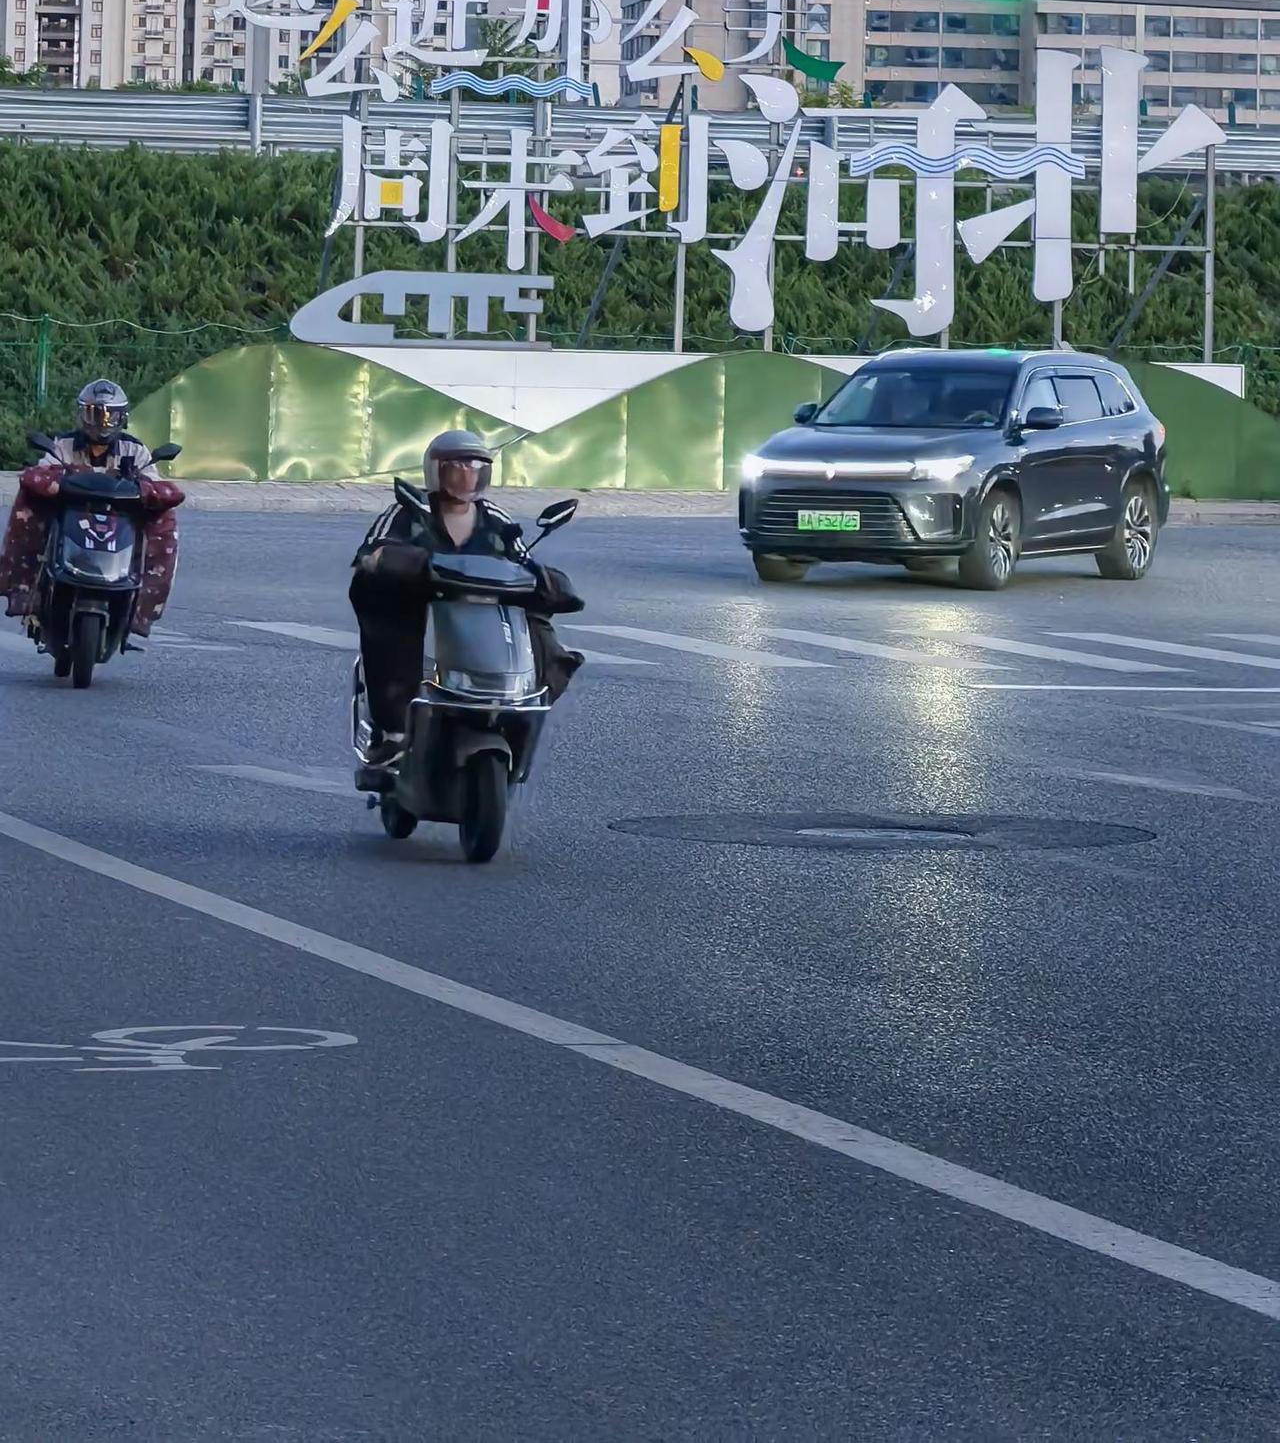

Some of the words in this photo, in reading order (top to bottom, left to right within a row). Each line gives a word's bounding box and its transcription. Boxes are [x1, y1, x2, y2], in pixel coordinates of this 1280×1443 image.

[324, 45, 1228, 336] 周末到河北
